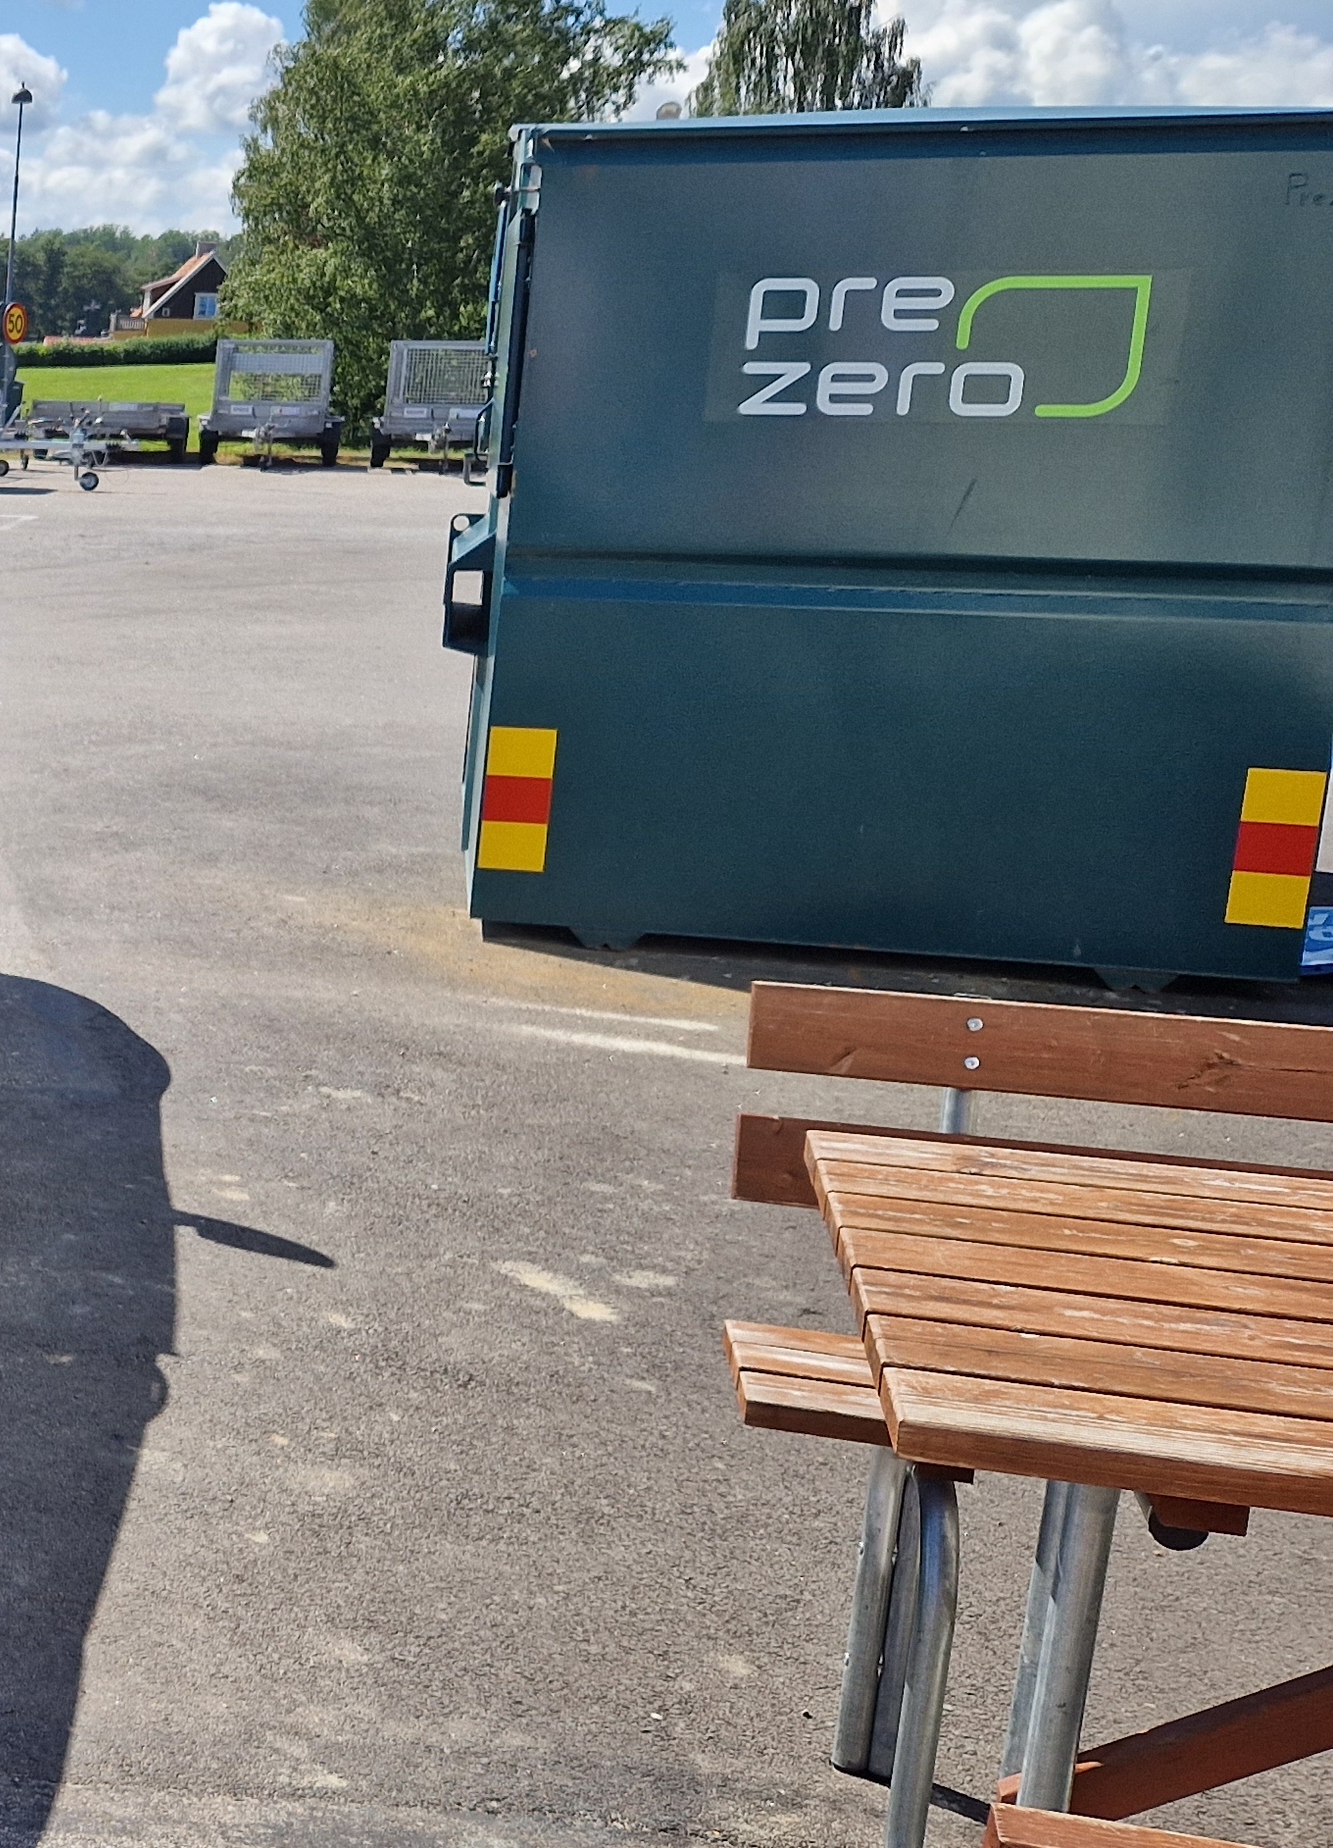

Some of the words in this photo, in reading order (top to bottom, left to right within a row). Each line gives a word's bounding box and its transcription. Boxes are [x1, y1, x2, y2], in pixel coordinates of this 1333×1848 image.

[1285, 172, 1333, 207] Pre
[8, 313, 24, 334] 50
[745, 276, 955, 350] pre
[738, 361, 1025, 417] zero
